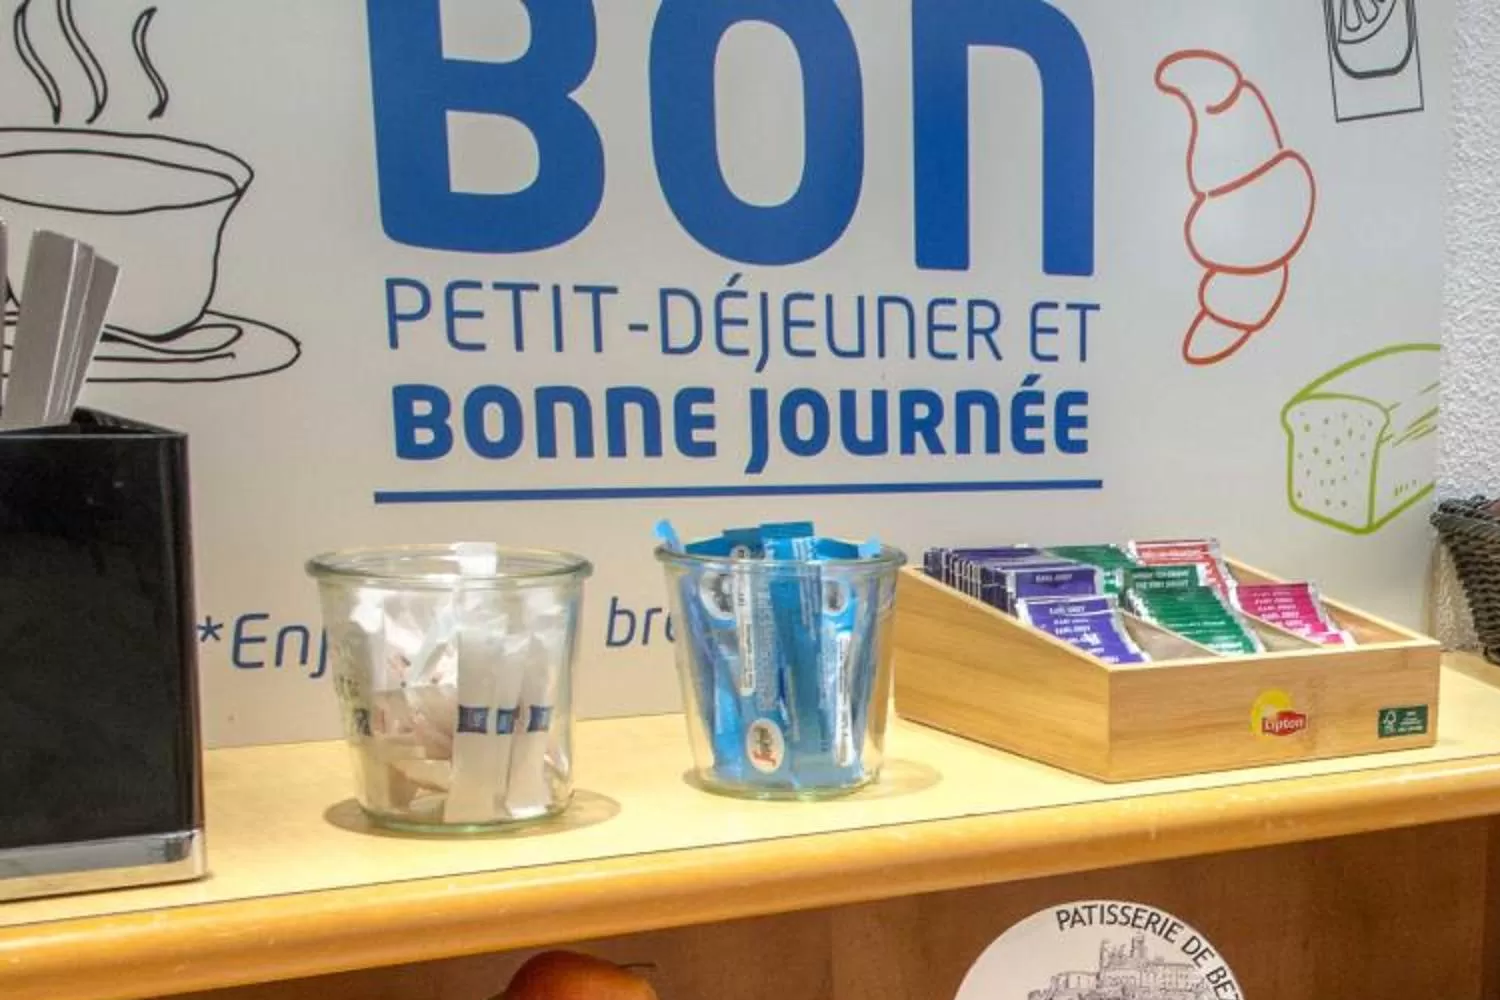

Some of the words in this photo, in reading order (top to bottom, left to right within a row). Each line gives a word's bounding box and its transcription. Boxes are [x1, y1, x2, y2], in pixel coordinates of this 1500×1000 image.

[385, 275, 1001, 372] PETIT-DÉJEUNER
[1030, 302, 1100, 363] ET
[391, 383, 716, 460] BONNE
[744, 374, 1089, 474] JOURNÉE
[1264, 718, 1304, 733] Lipton
[1056, 903, 1184, 943] PATISSERIE
[1181, 935, 1215, 968] DE
